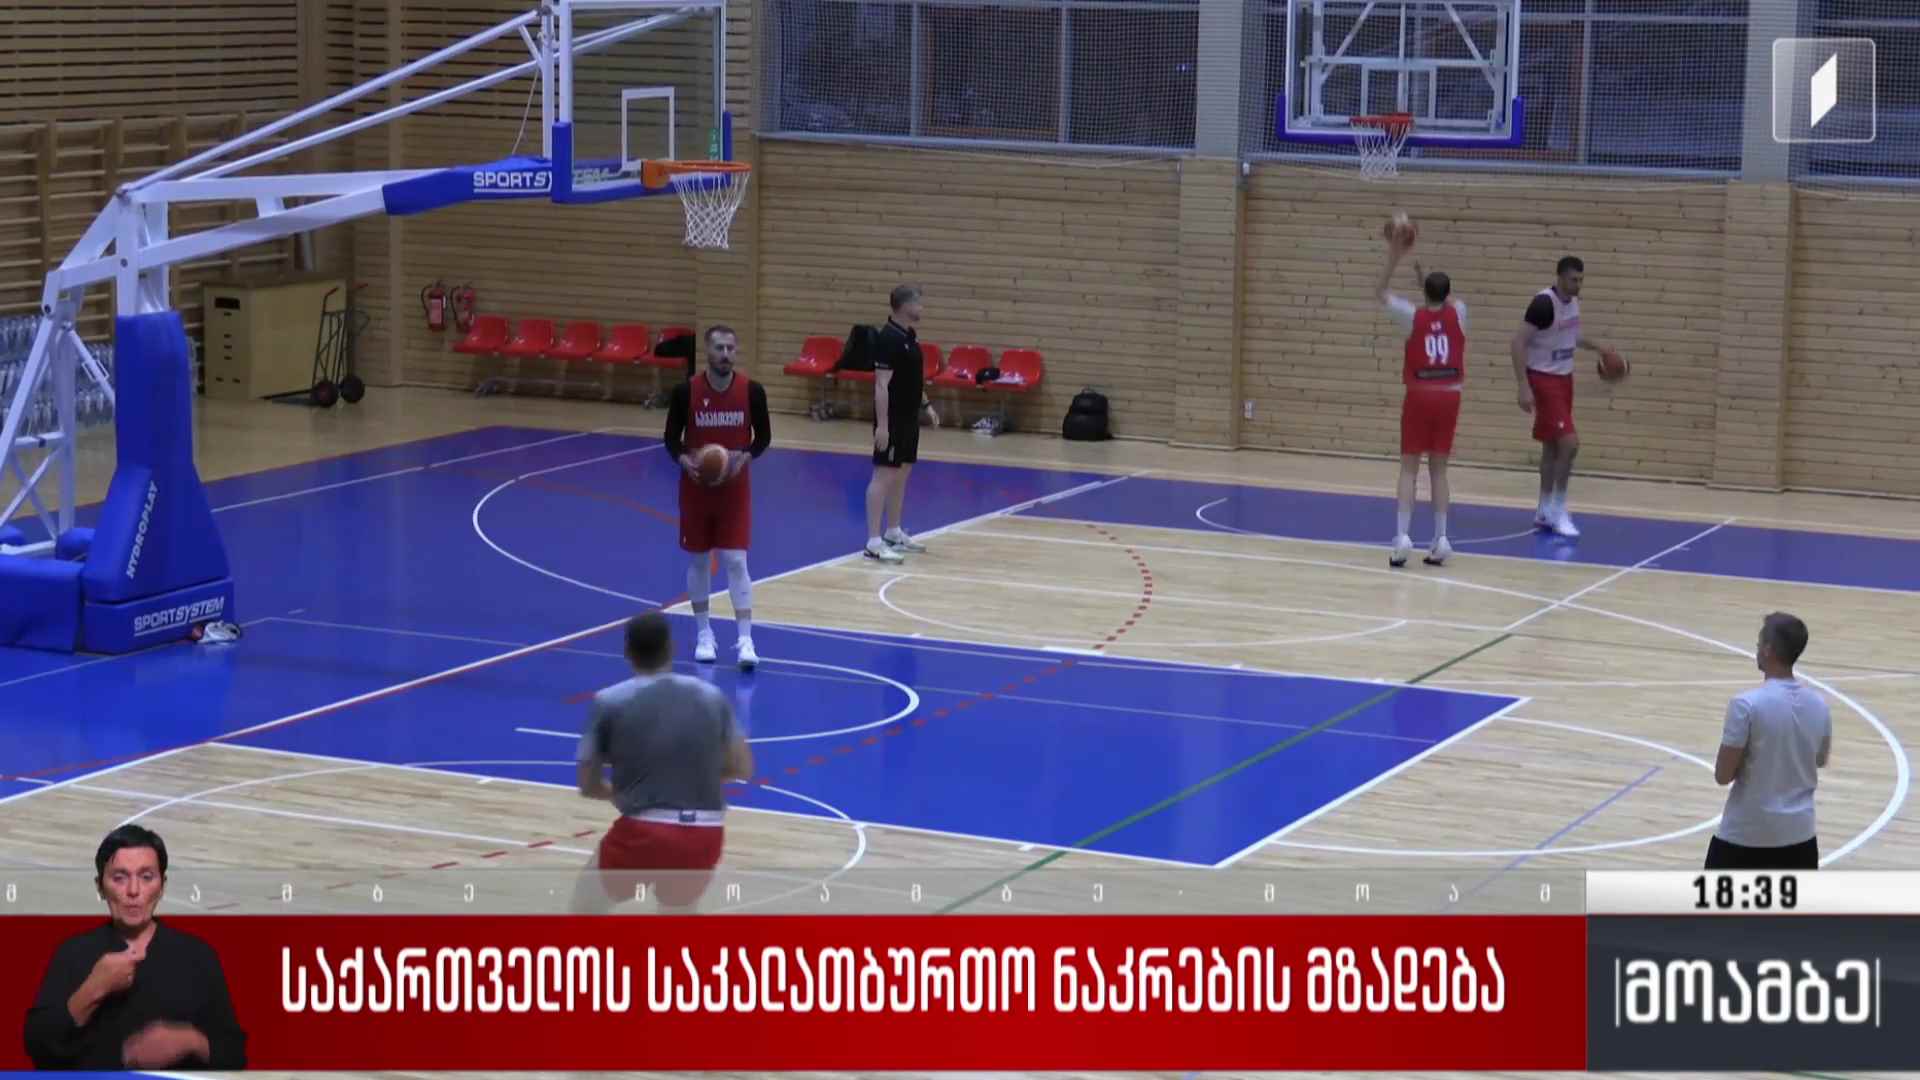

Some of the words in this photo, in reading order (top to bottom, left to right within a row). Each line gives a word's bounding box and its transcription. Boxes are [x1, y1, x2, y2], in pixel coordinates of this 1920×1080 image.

[1424, 334, 1449, 366] 99
[126, 480, 158, 580] HYDROPLAY
[134, 597, 225, 633] SPORTSYSTEM
